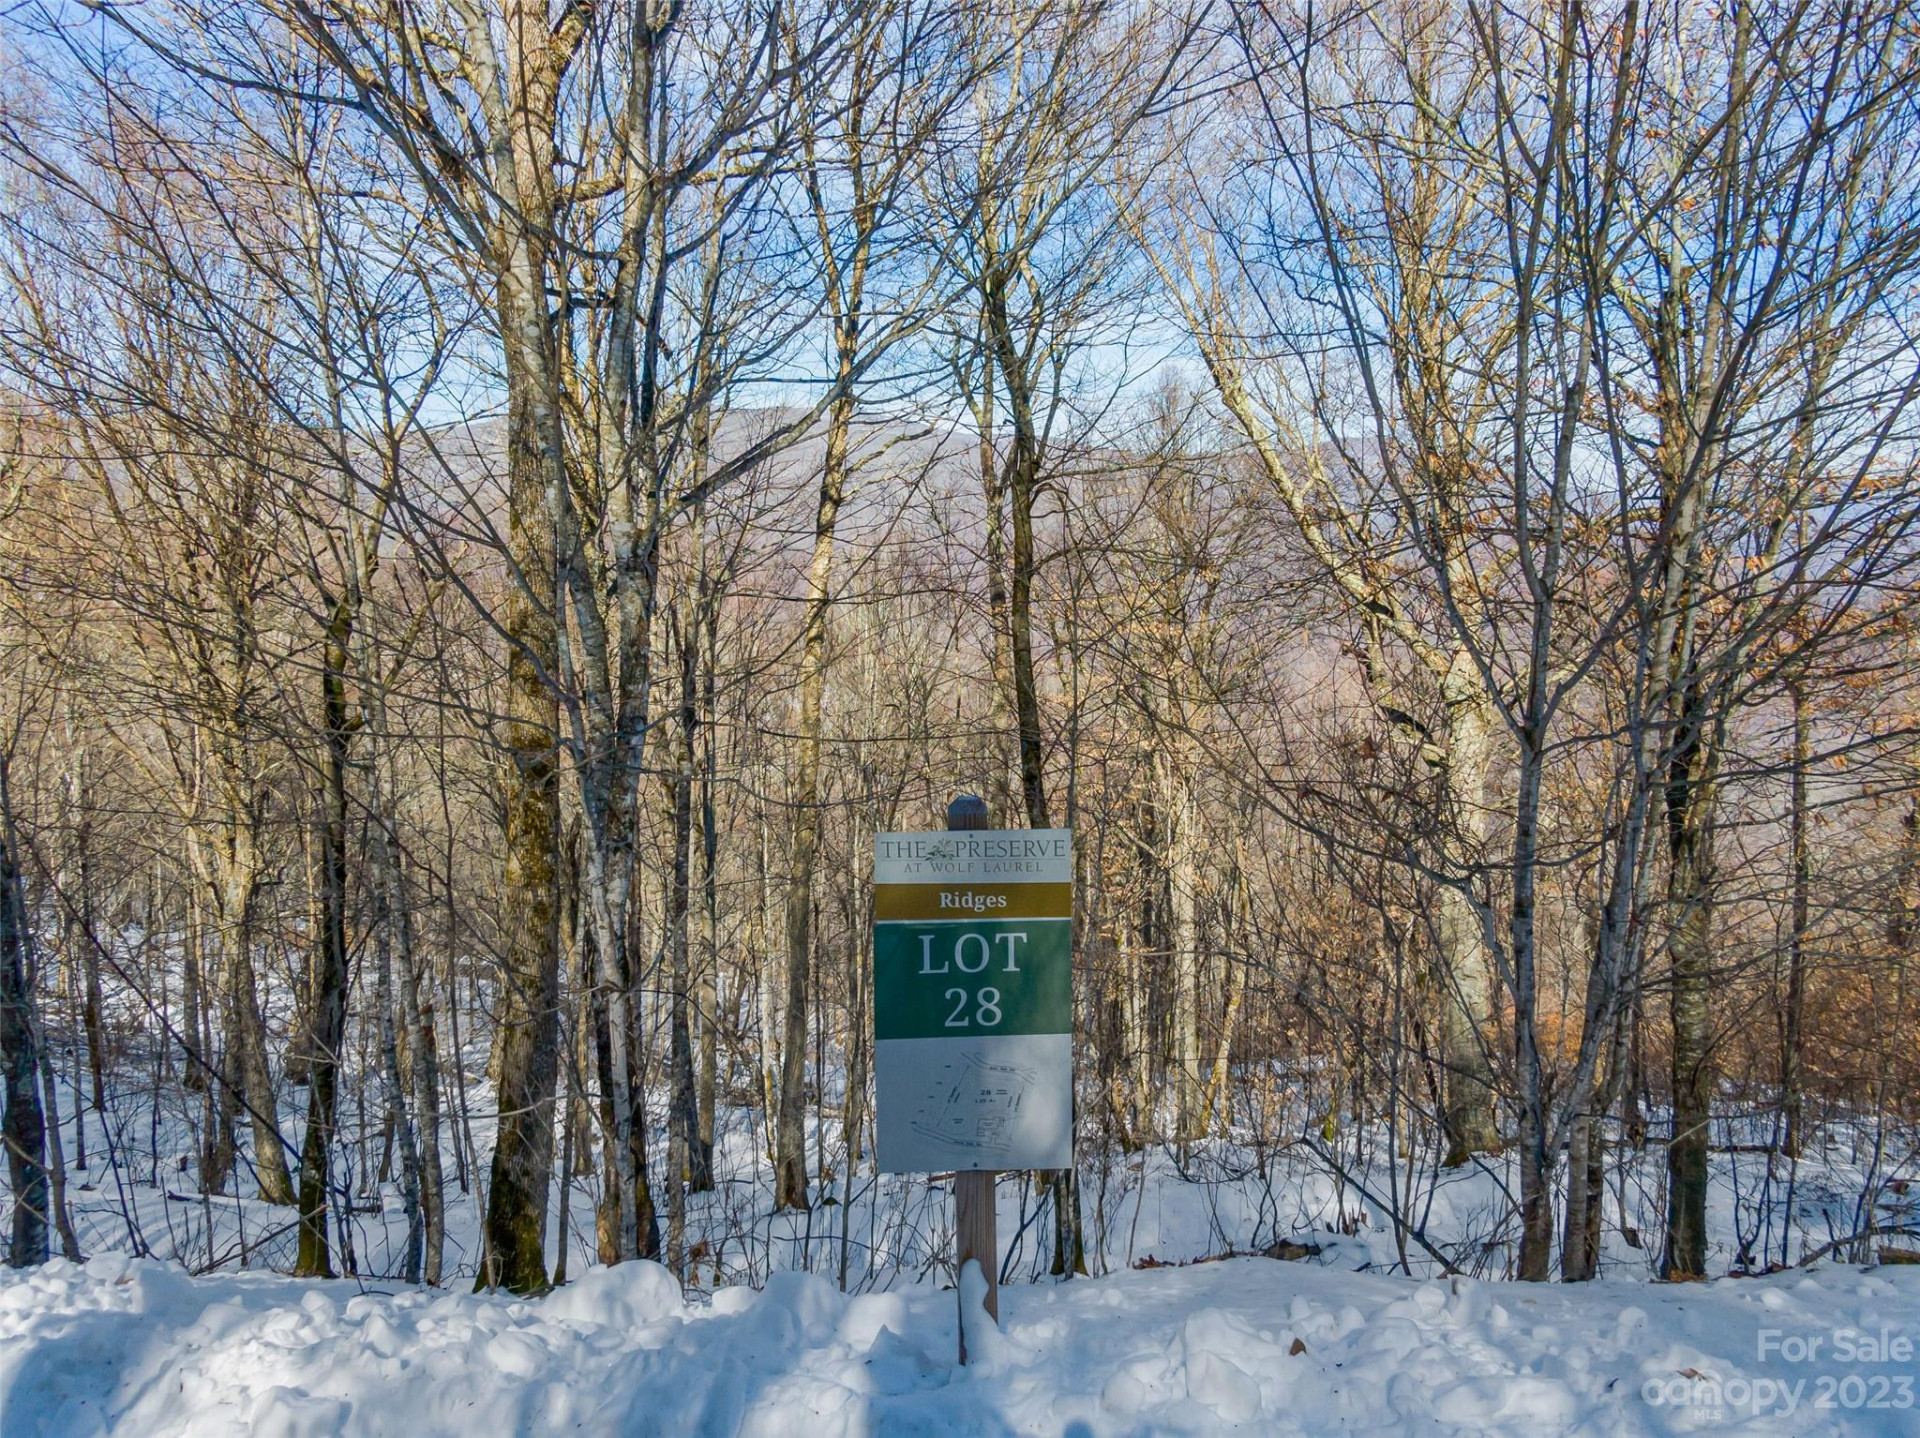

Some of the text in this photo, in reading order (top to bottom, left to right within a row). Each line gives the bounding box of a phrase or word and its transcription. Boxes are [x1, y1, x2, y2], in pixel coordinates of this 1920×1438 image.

[881, 839, 1066, 858] THE PRESERVE
[904, 861, 1043, 873] AT WOLF LAUREL
[939, 892, 1007, 912] Ridges
[918, 933, 1027, 974] LOT
[944, 987, 1002, 1027] 28
